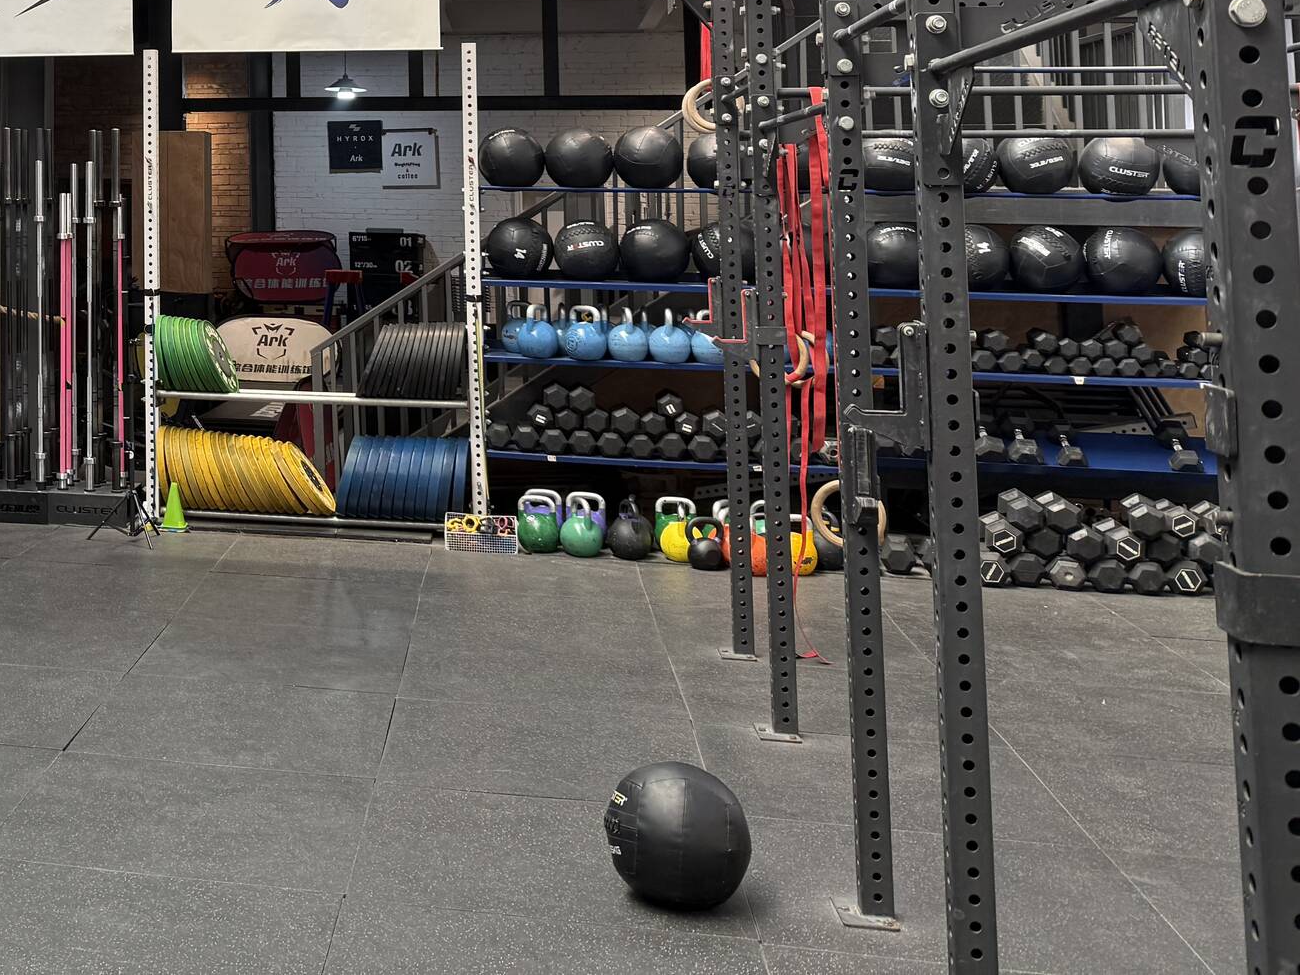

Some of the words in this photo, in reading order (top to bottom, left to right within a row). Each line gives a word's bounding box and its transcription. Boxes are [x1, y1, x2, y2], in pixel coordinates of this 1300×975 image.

[390, 142, 423, 157] Ark
[350, 154, 364, 163] Ark
[1108, 165, 1150, 178] CLUSTER
[400, 236, 412, 248] 01
[1103, 229, 1114, 260] CLUSTER
[276, 256, 297, 267] Ark
[395, 259, 413, 273] 02
[256, 334, 289, 347] Ark
